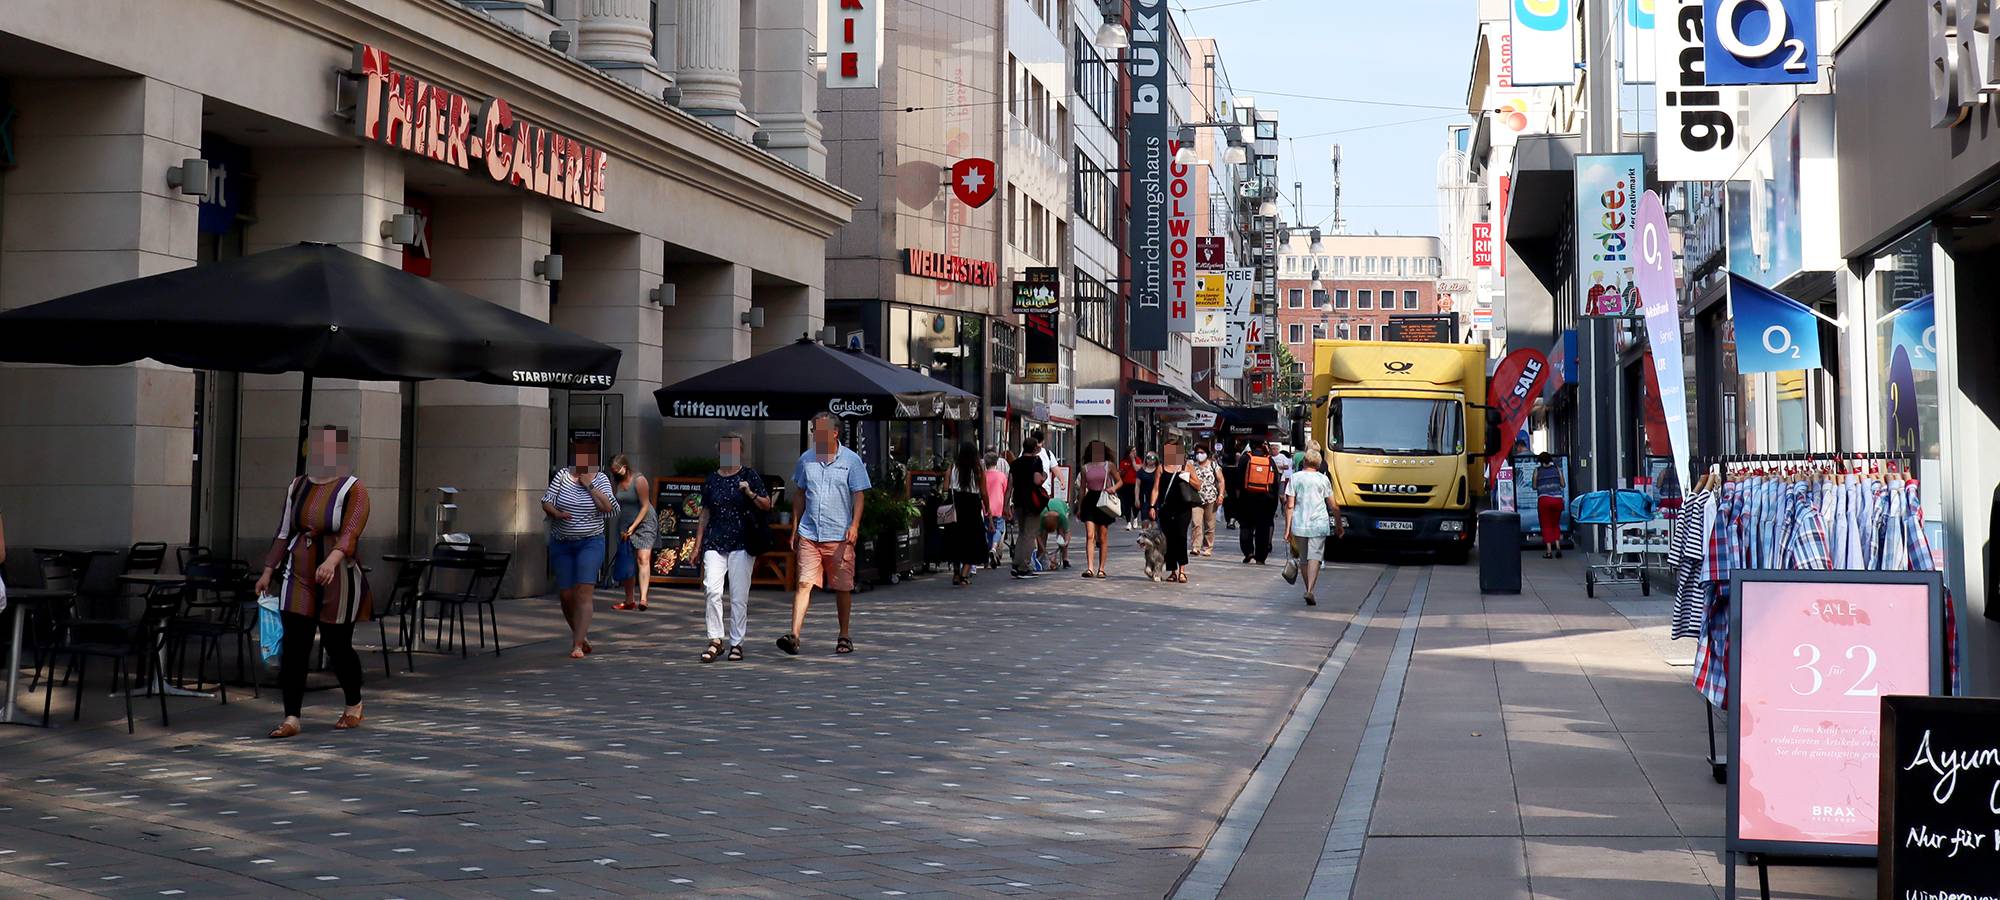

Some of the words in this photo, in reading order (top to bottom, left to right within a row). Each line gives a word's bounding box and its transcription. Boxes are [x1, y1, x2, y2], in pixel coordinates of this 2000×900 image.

[1497, 34, 1512, 88] Plasma
[1628, 168, 1636, 215] creativmarkt
[1140, 136, 1164, 309] Einrichtungshaus
[1168, 139, 1190, 319] WOOLWORTH
[909, 248, 998, 287] WELLENSTEYN
[1015, 295, 1049, 308] Mahal
[1017, 284, 1033, 298] Taj
[512, 370, 573, 384] STARBUCKS
[1514, 358, 1542, 398] SALE
[673, 400, 769, 418] frittenwerk
[829, 398, 873, 417] Carlsberg
[1372, 484, 1418, 494] IVECO
[1811, 603, 1857, 617] SALE
[1790, 643, 1823, 697] 3
[1827, 665, 1846, 676] für
[1843, 645, 1878, 697] 2
[1812, 806, 1856, 817] BRAX
[1906, 825, 1947, 848] Nur
[1948, 828, 1986, 858] für
